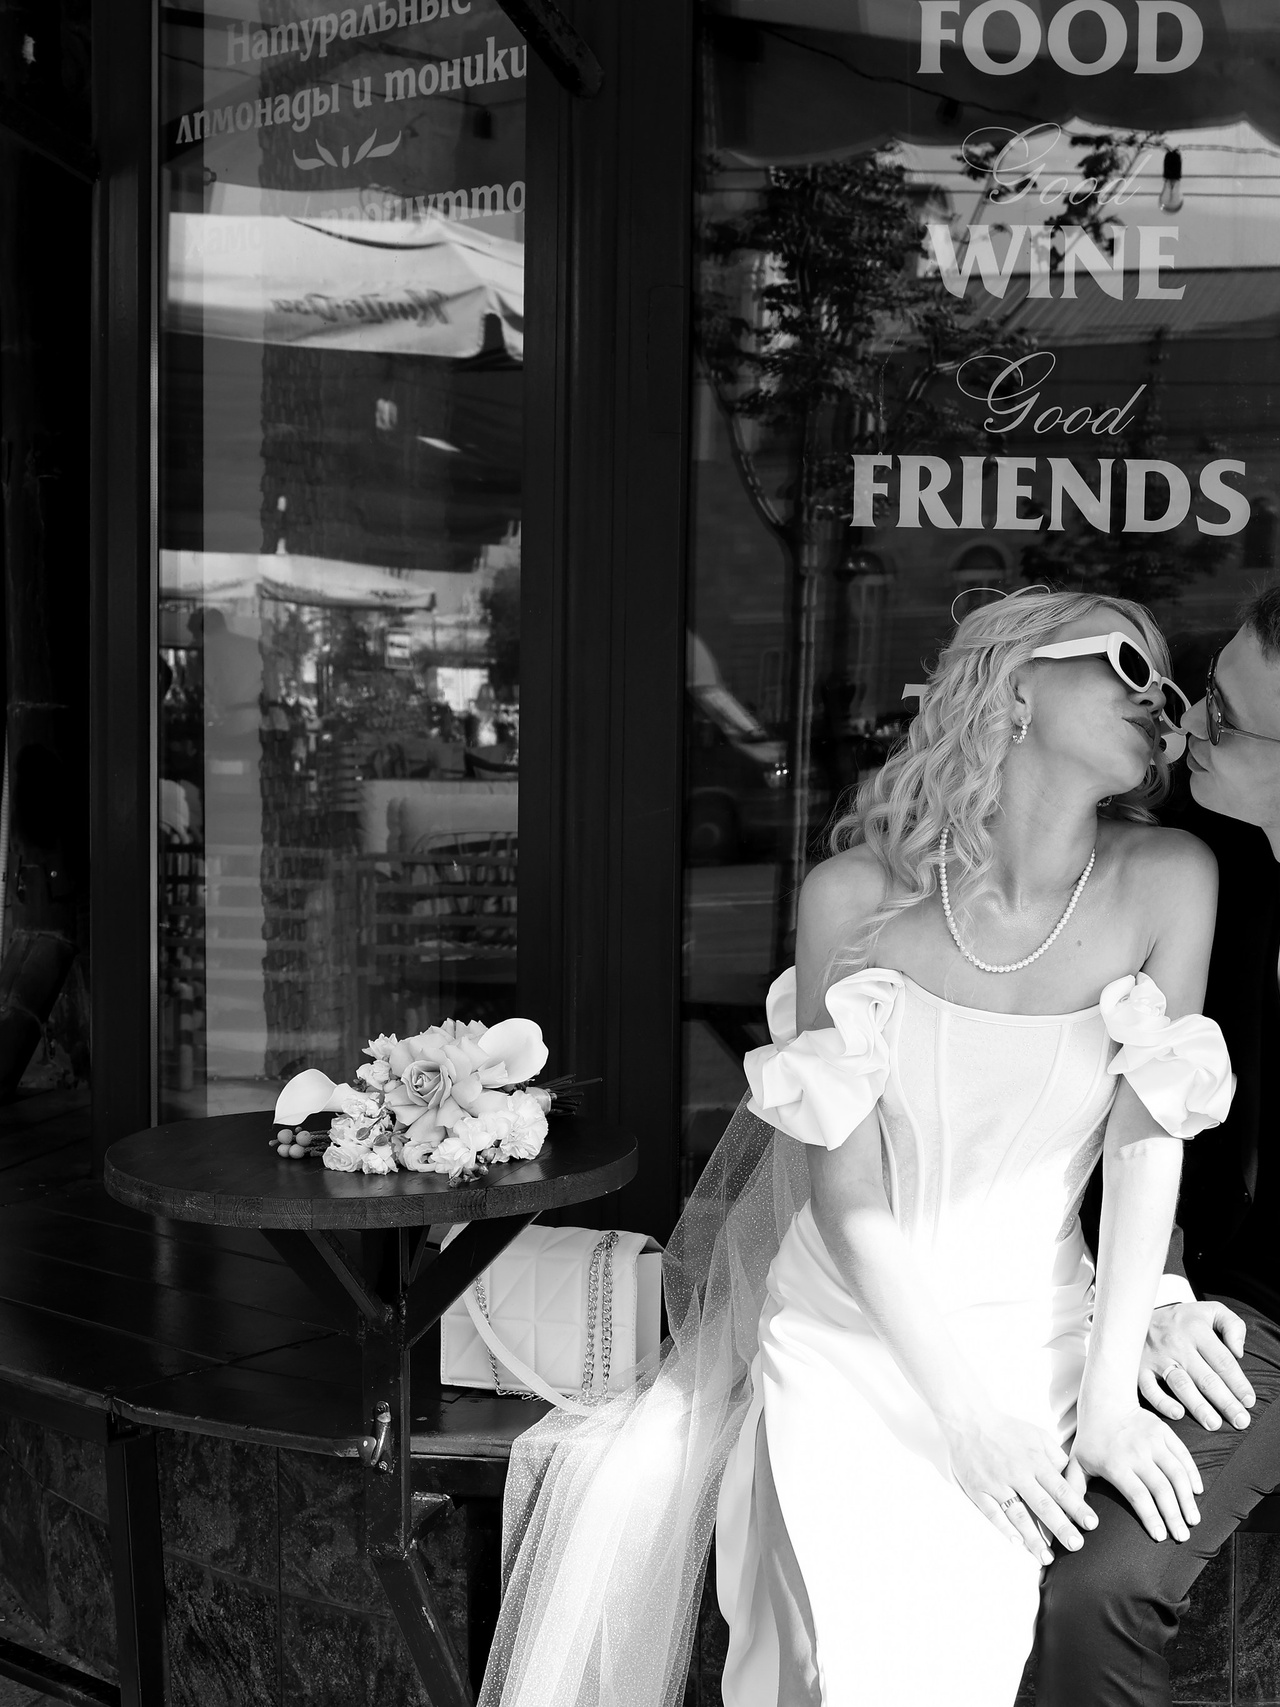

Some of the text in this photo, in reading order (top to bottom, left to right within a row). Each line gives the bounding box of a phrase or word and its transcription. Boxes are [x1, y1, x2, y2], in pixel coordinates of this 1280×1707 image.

[352, 76, 372, 109] и
[384, 37, 527, 103] тоники
[916, 0, 1204, 76] FOOD
[961, 122, 1153, 206] Good
[926, 223, 1188, 301] WINE
[956, 351, 1148, 436] Good
[848, 453, 1252, 538] FRIENDS
